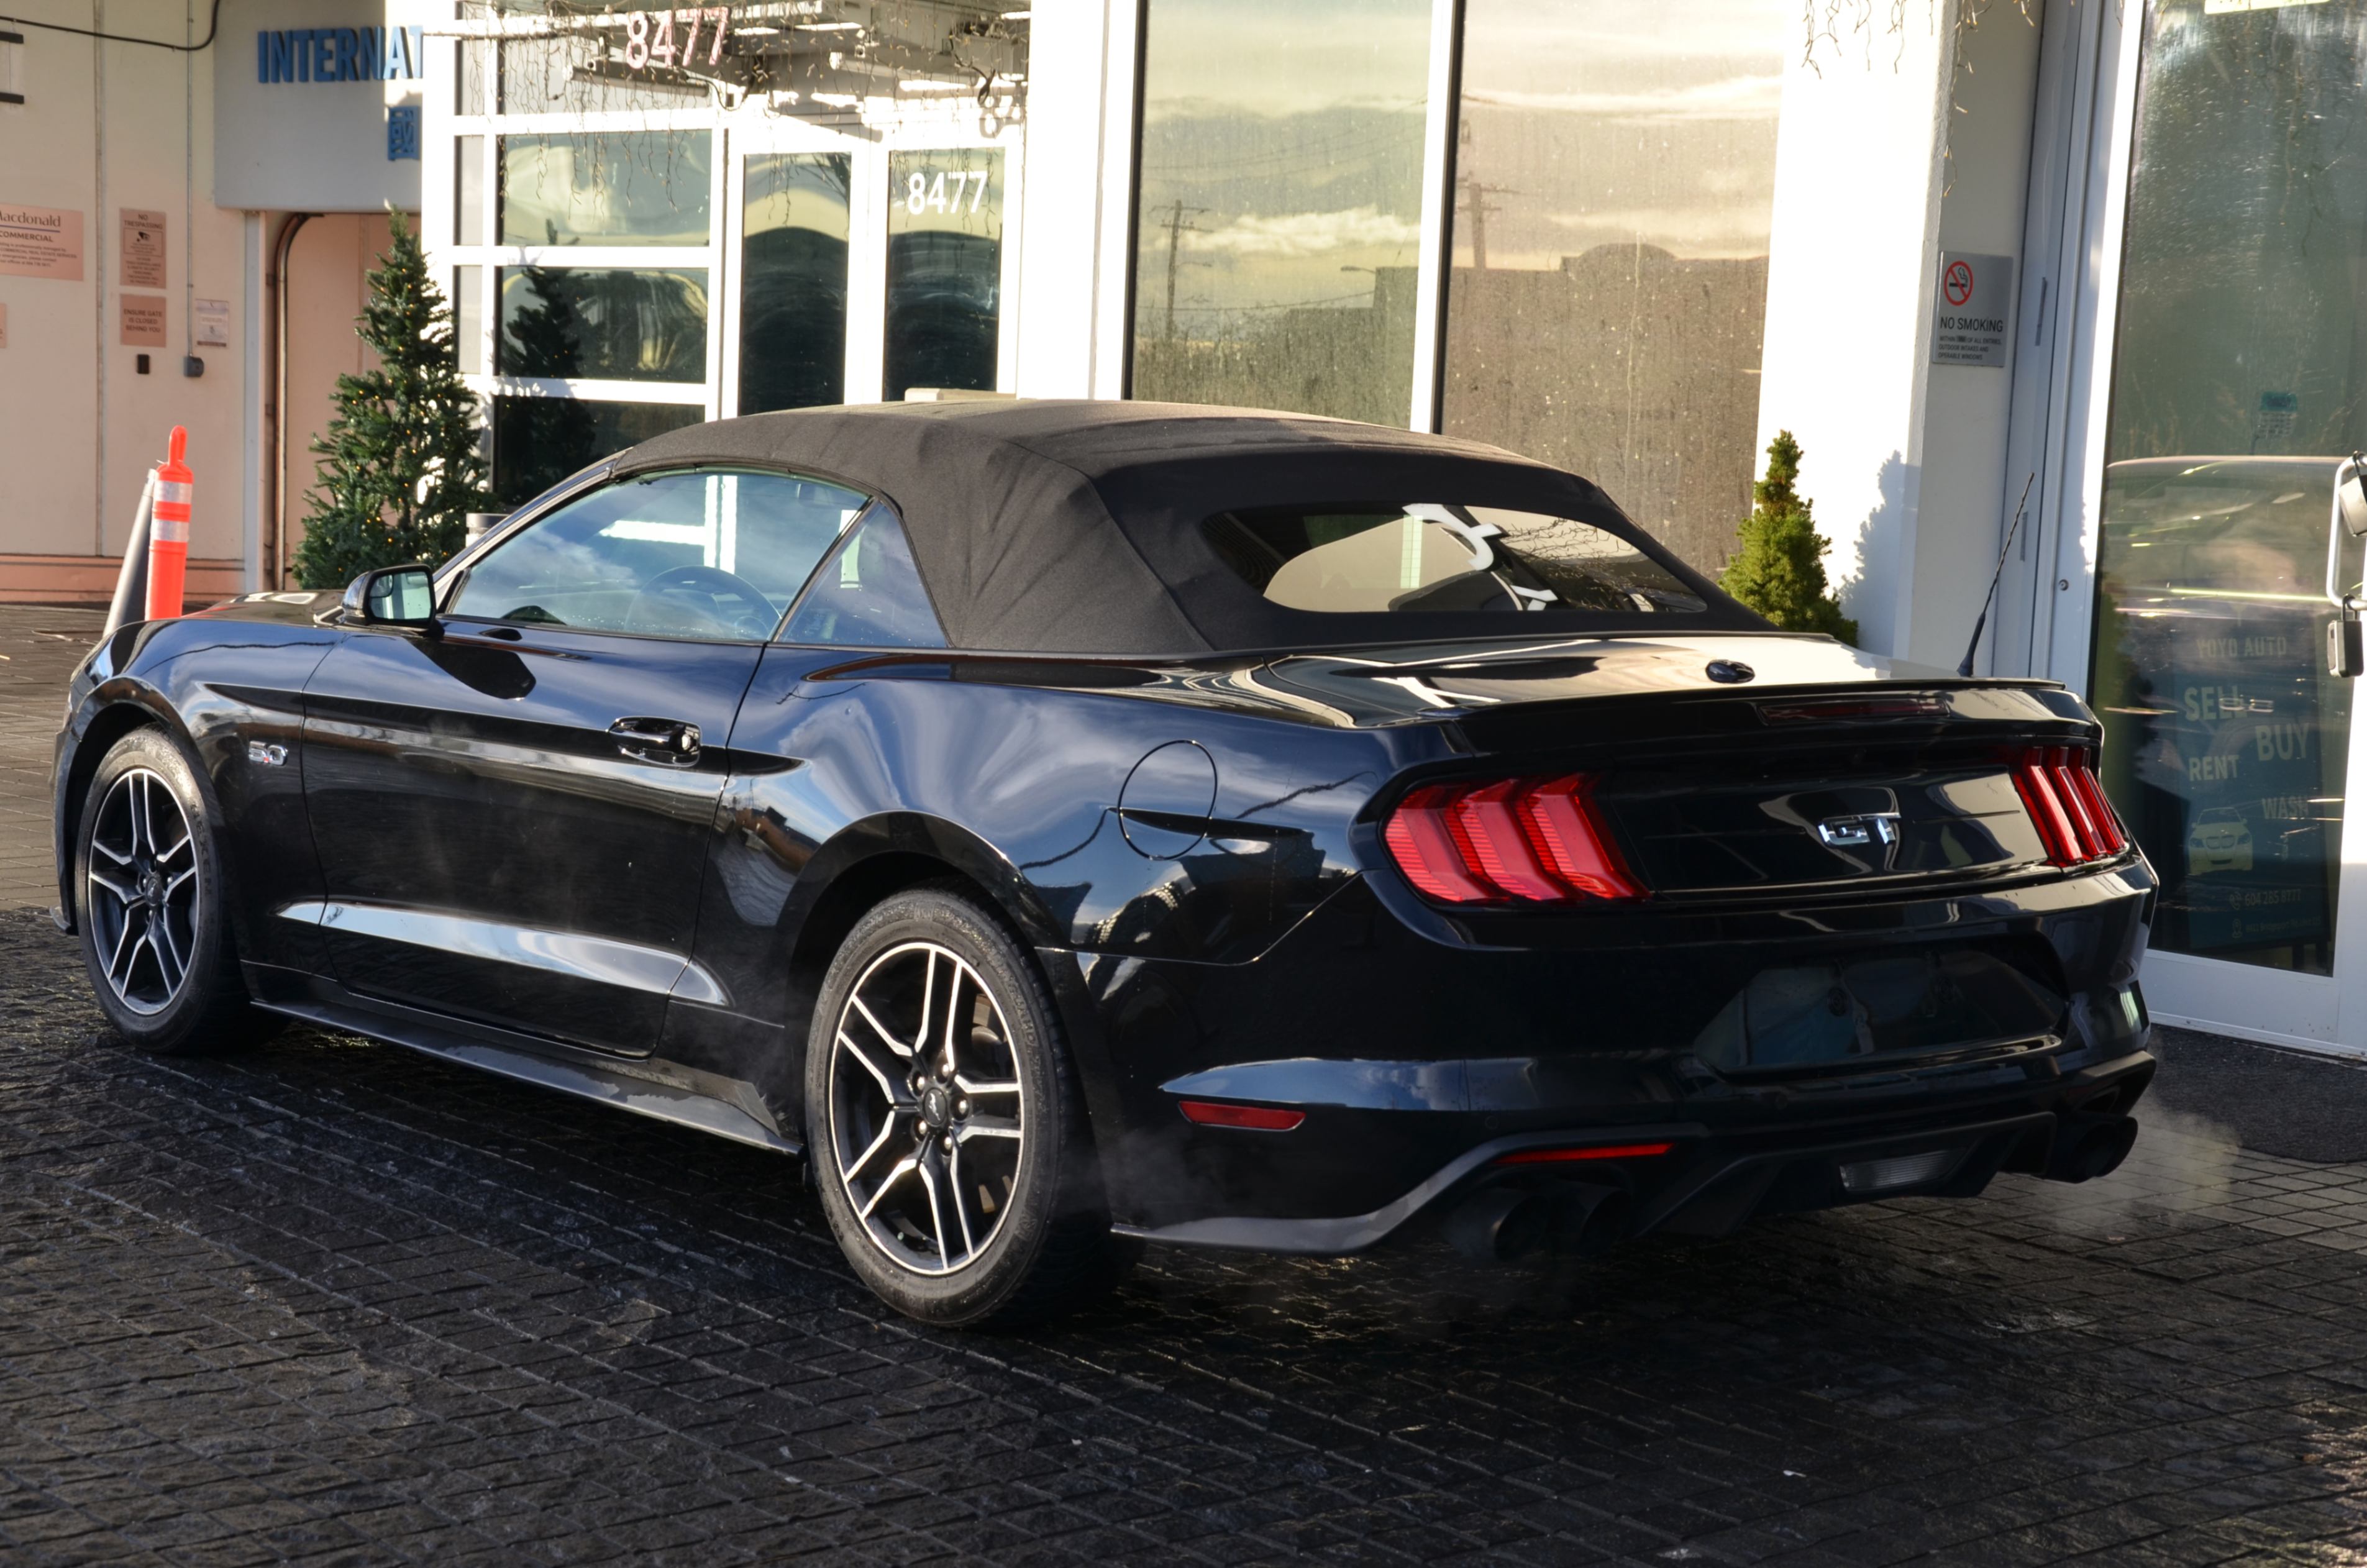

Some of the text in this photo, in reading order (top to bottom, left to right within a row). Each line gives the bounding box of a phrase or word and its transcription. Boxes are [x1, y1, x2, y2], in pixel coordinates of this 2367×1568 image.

[626, 7, 729, 69] 8477
[908, 171, 988, 215] 8477
[1940, 316, 2004, 332] NO SMOKING
[2196, 636, 2287, 658] YOYO AUTO
[2184, 686, 2247, 721] SELL
[2255, 722, 2310, 761] BUY
[2189, 755, 2239, 782] RENT
[2261, 796, 2309, 819] WASH
[1818, 812, 1901, 846] GT
